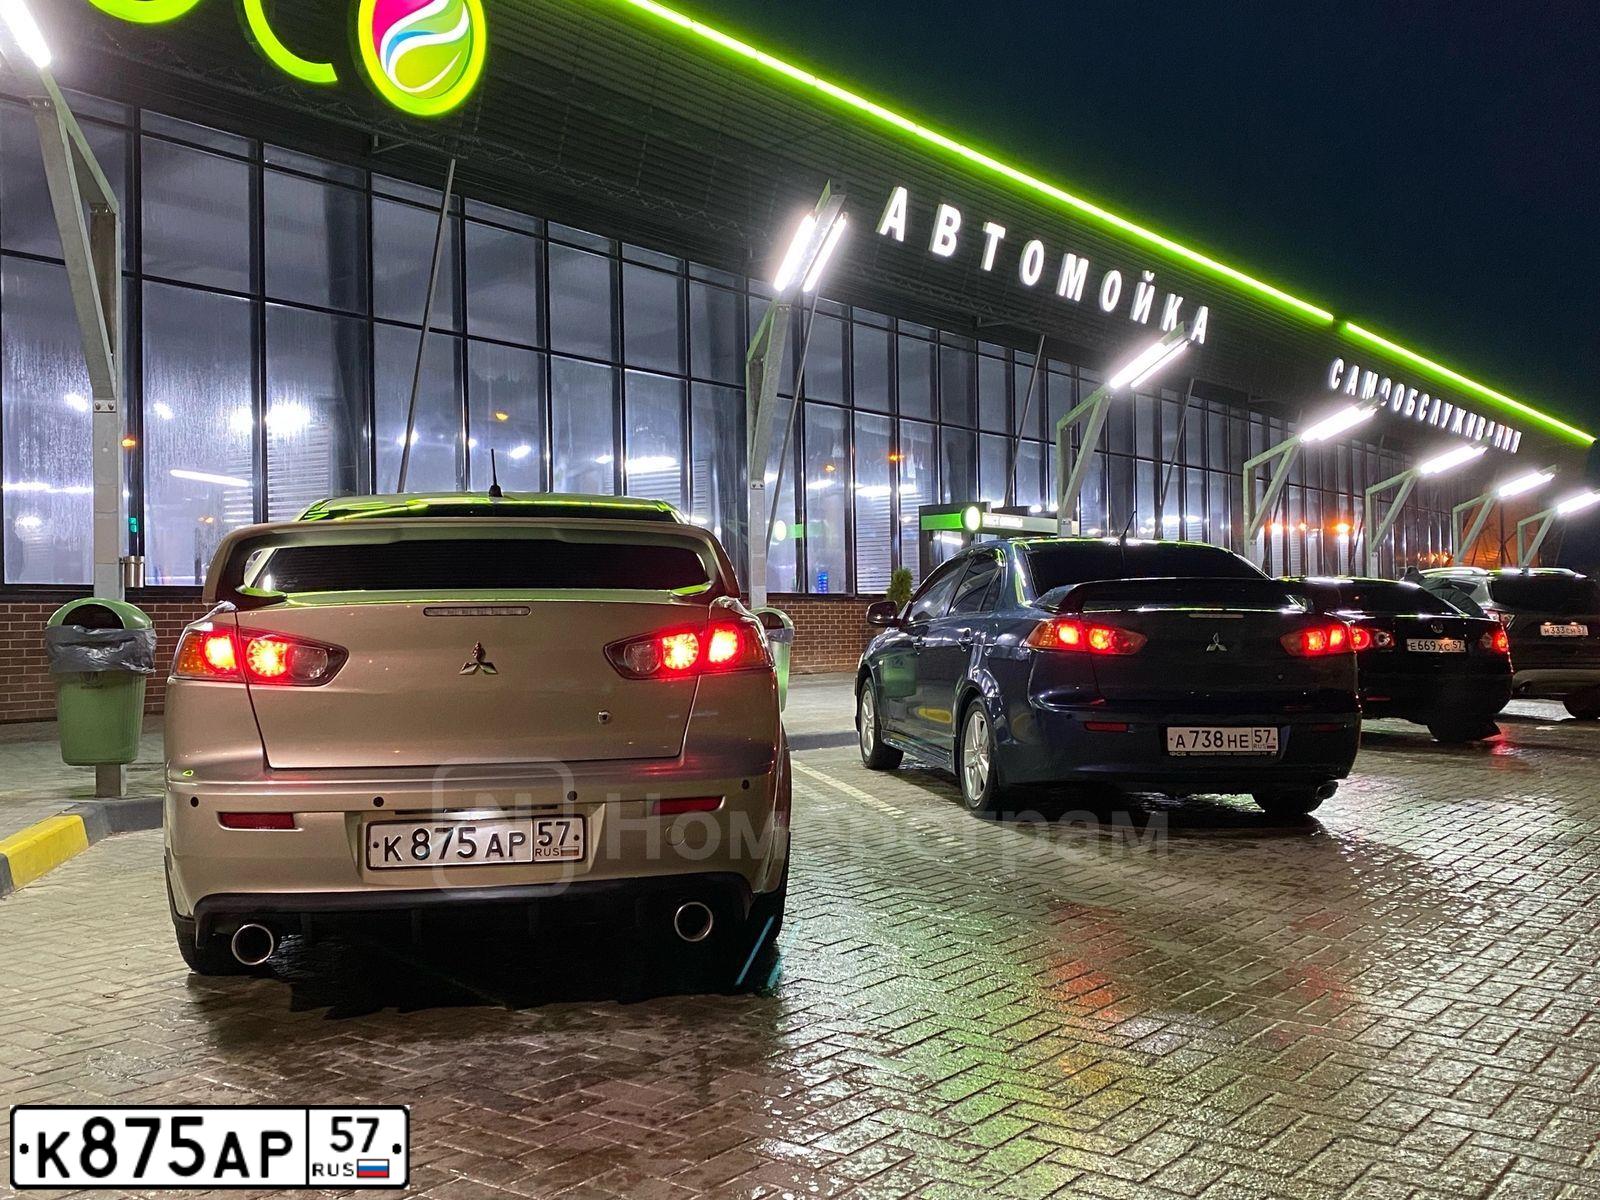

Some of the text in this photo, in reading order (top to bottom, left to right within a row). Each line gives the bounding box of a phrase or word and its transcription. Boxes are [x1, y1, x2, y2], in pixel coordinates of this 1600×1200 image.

[877, 186, 1209, 344] АВТОМОЙКА
[1175, 729, 1271, 749] А738НЕ 57
[384, 821, 571, 862] К875АР 57
[535, 847, 560, 857] RUS
